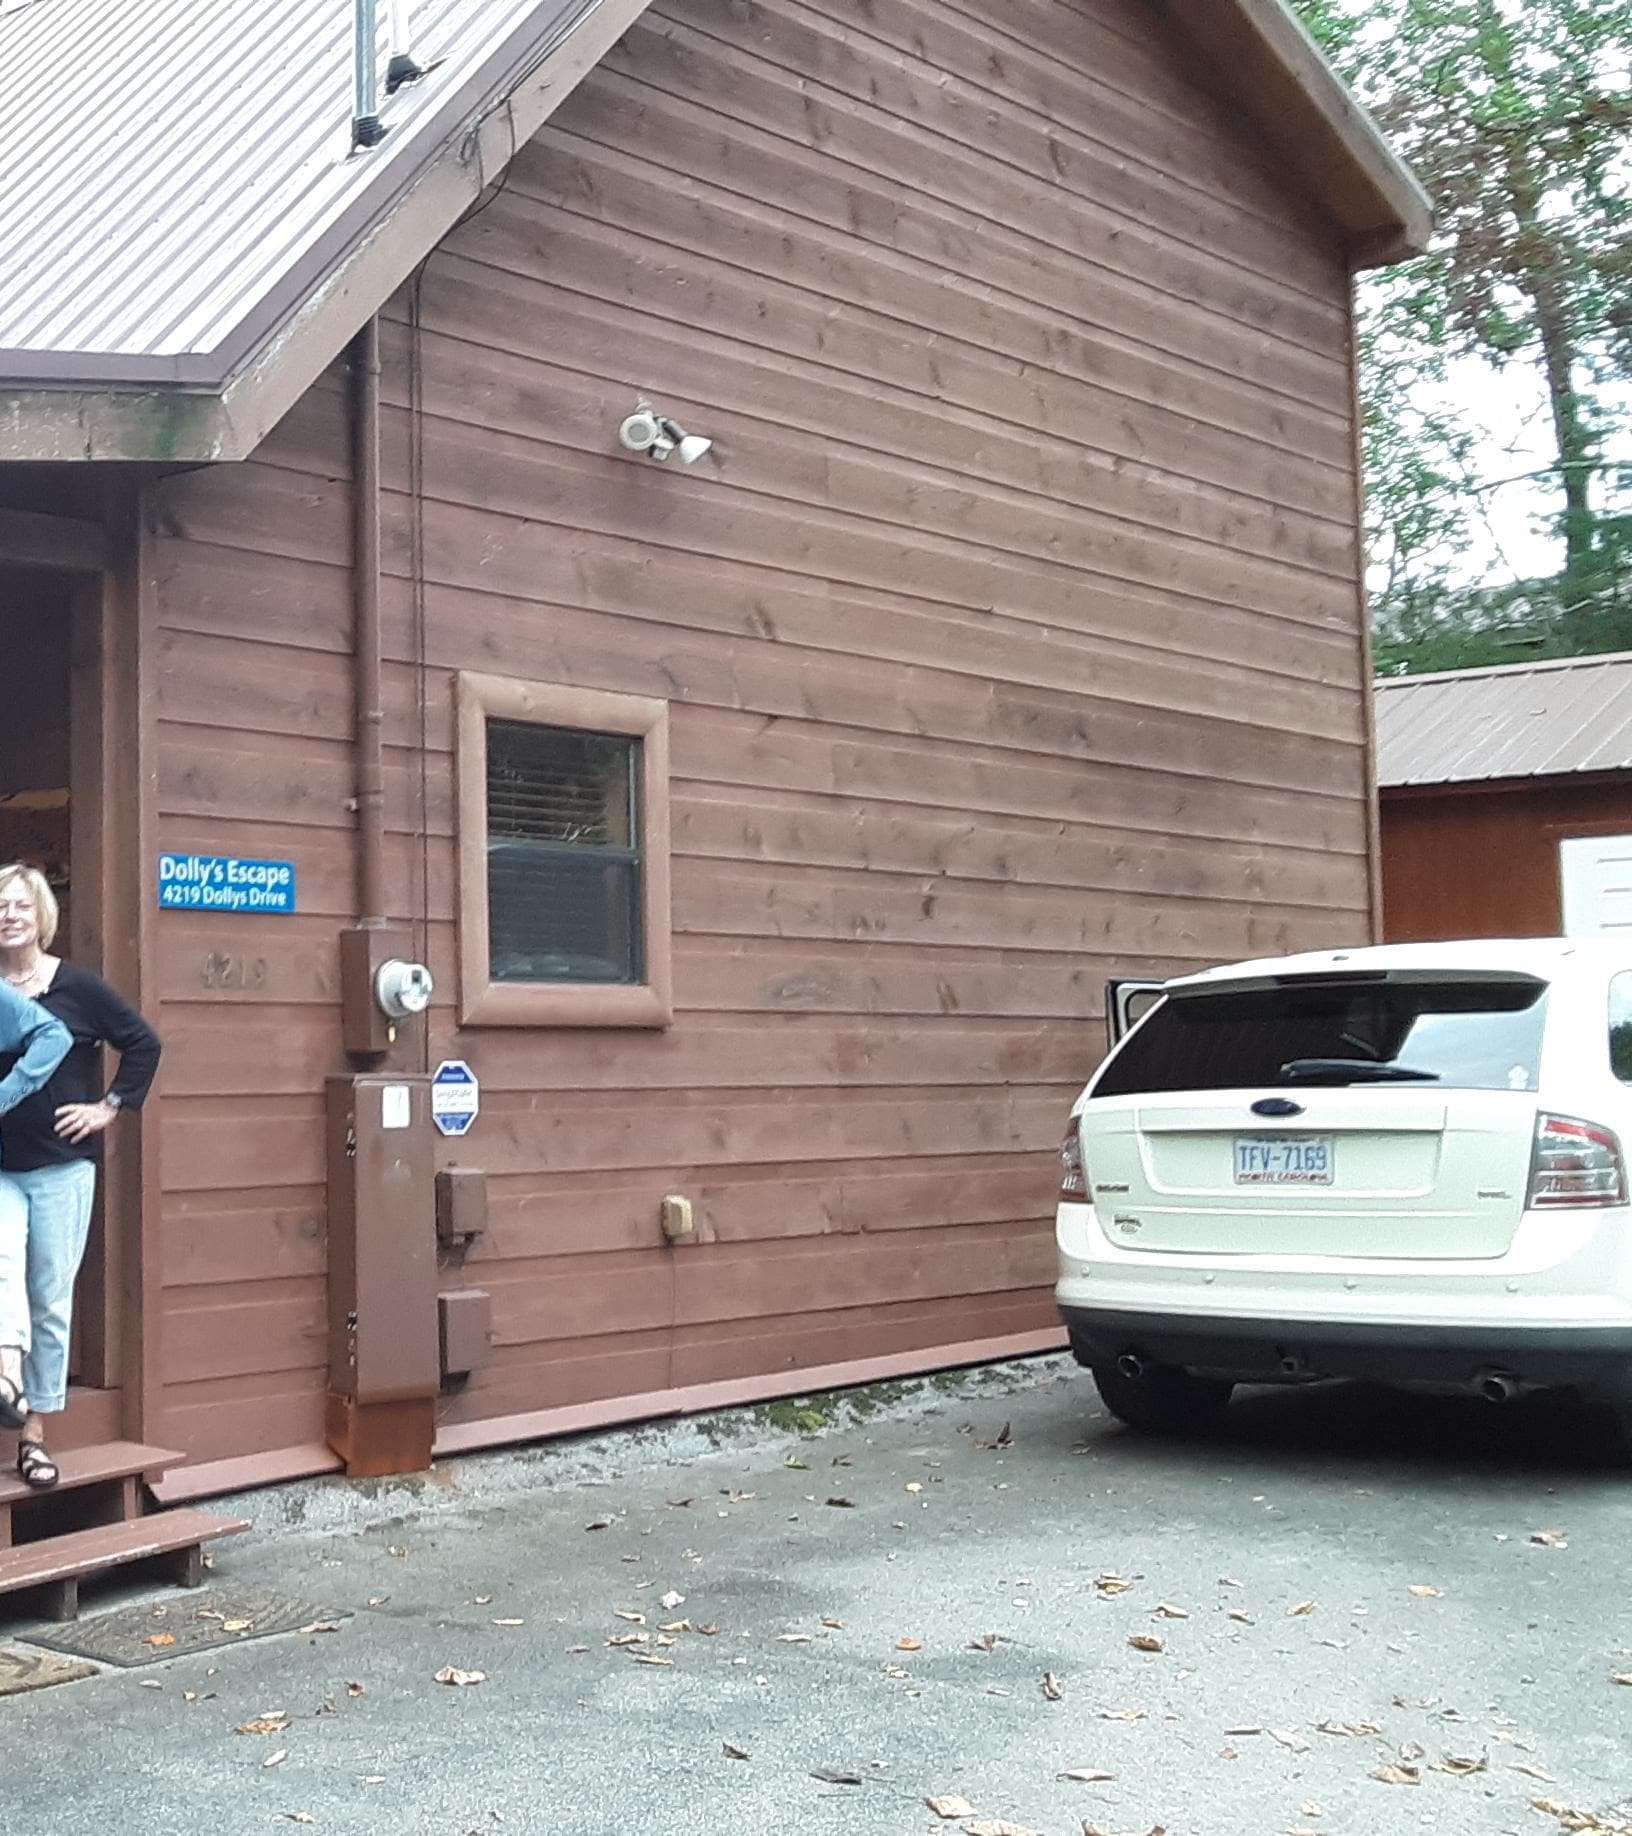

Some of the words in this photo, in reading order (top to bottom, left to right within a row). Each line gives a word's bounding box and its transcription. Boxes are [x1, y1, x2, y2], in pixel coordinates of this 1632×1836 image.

[159, 856, 224, 888] Dolly's
[228, 860, 290, 893] Escape
[163, 884, 201, 904] 4219
[203, 886, 248, 910] Dollys
[249, 887, 287, 906] Drive
[1238, 1145, 1328, 1171] TFV-7169
